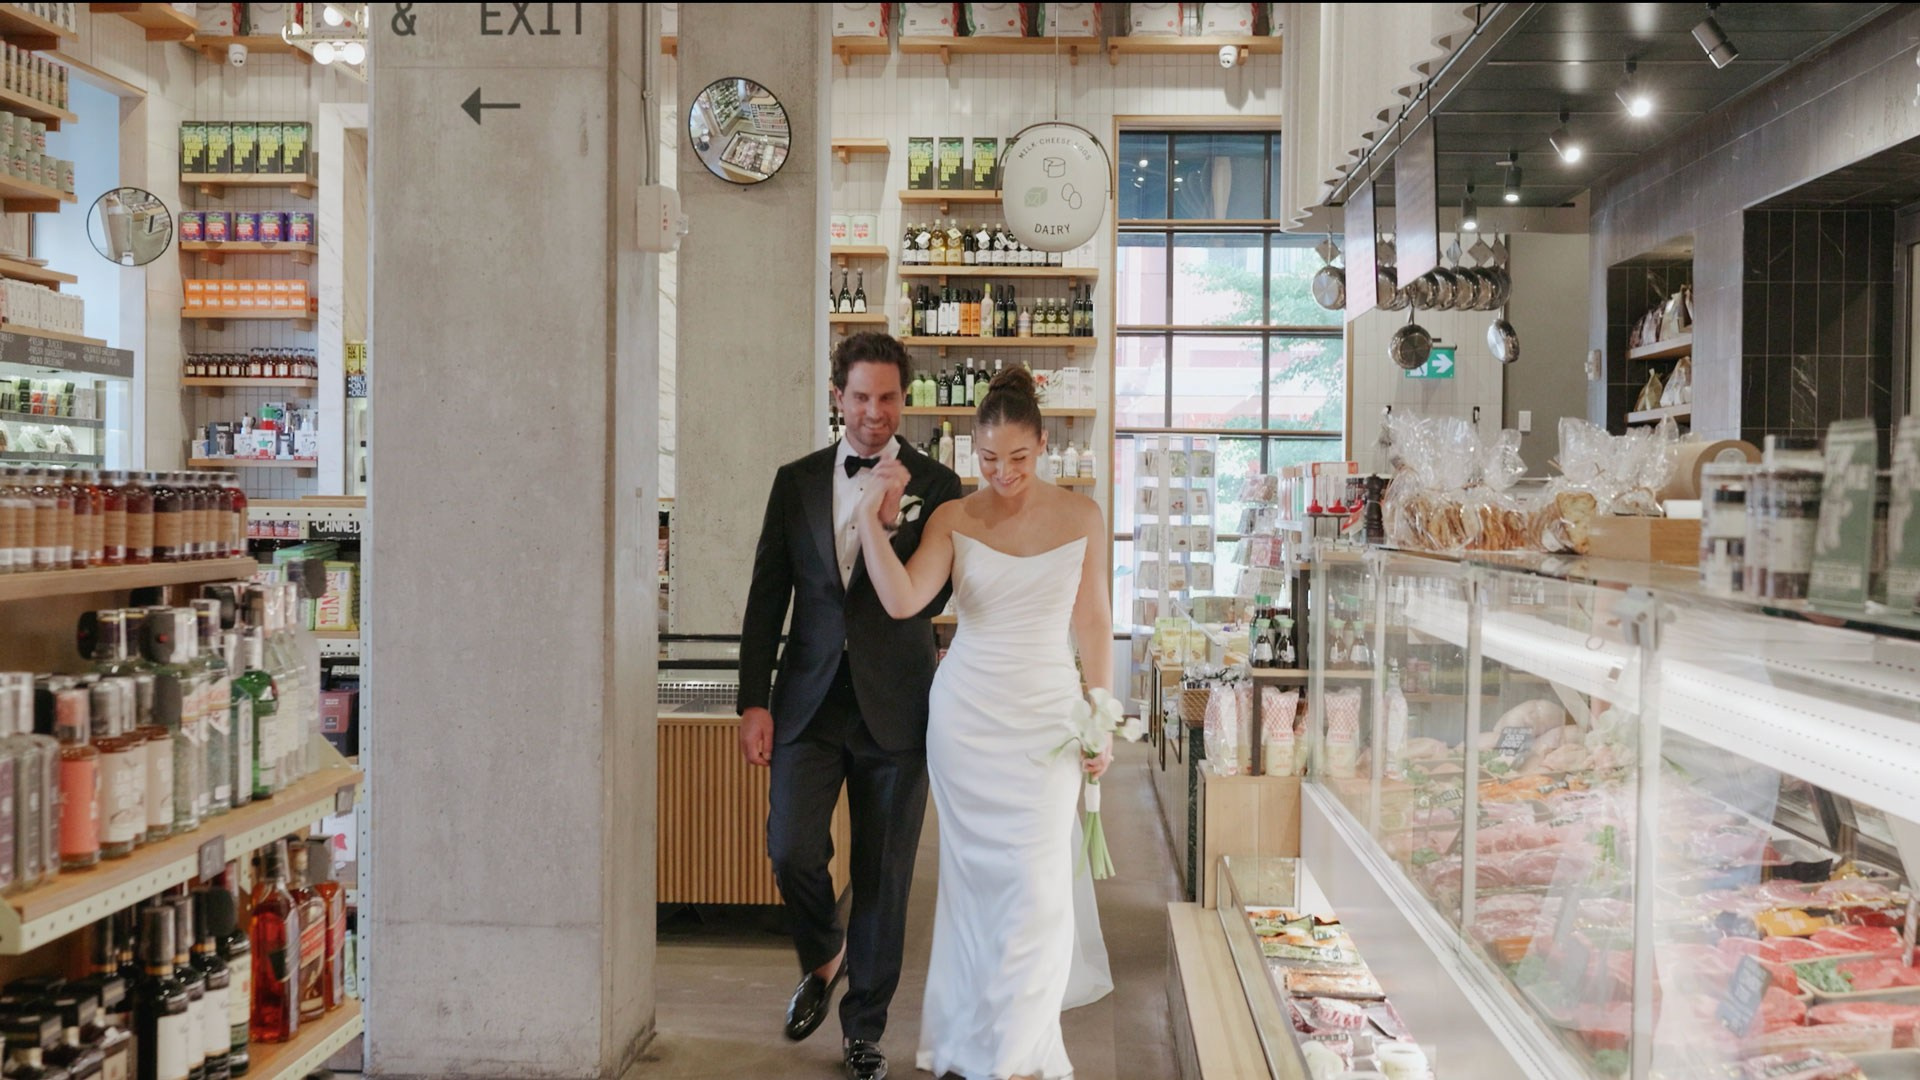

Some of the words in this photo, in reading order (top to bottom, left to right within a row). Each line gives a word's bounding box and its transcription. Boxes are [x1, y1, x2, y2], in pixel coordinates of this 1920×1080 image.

[391, 3, 416, 36] &
[1039, 137, 1071, 145] CHEESE
[1034, 223, 1070, 235] DAIRY
